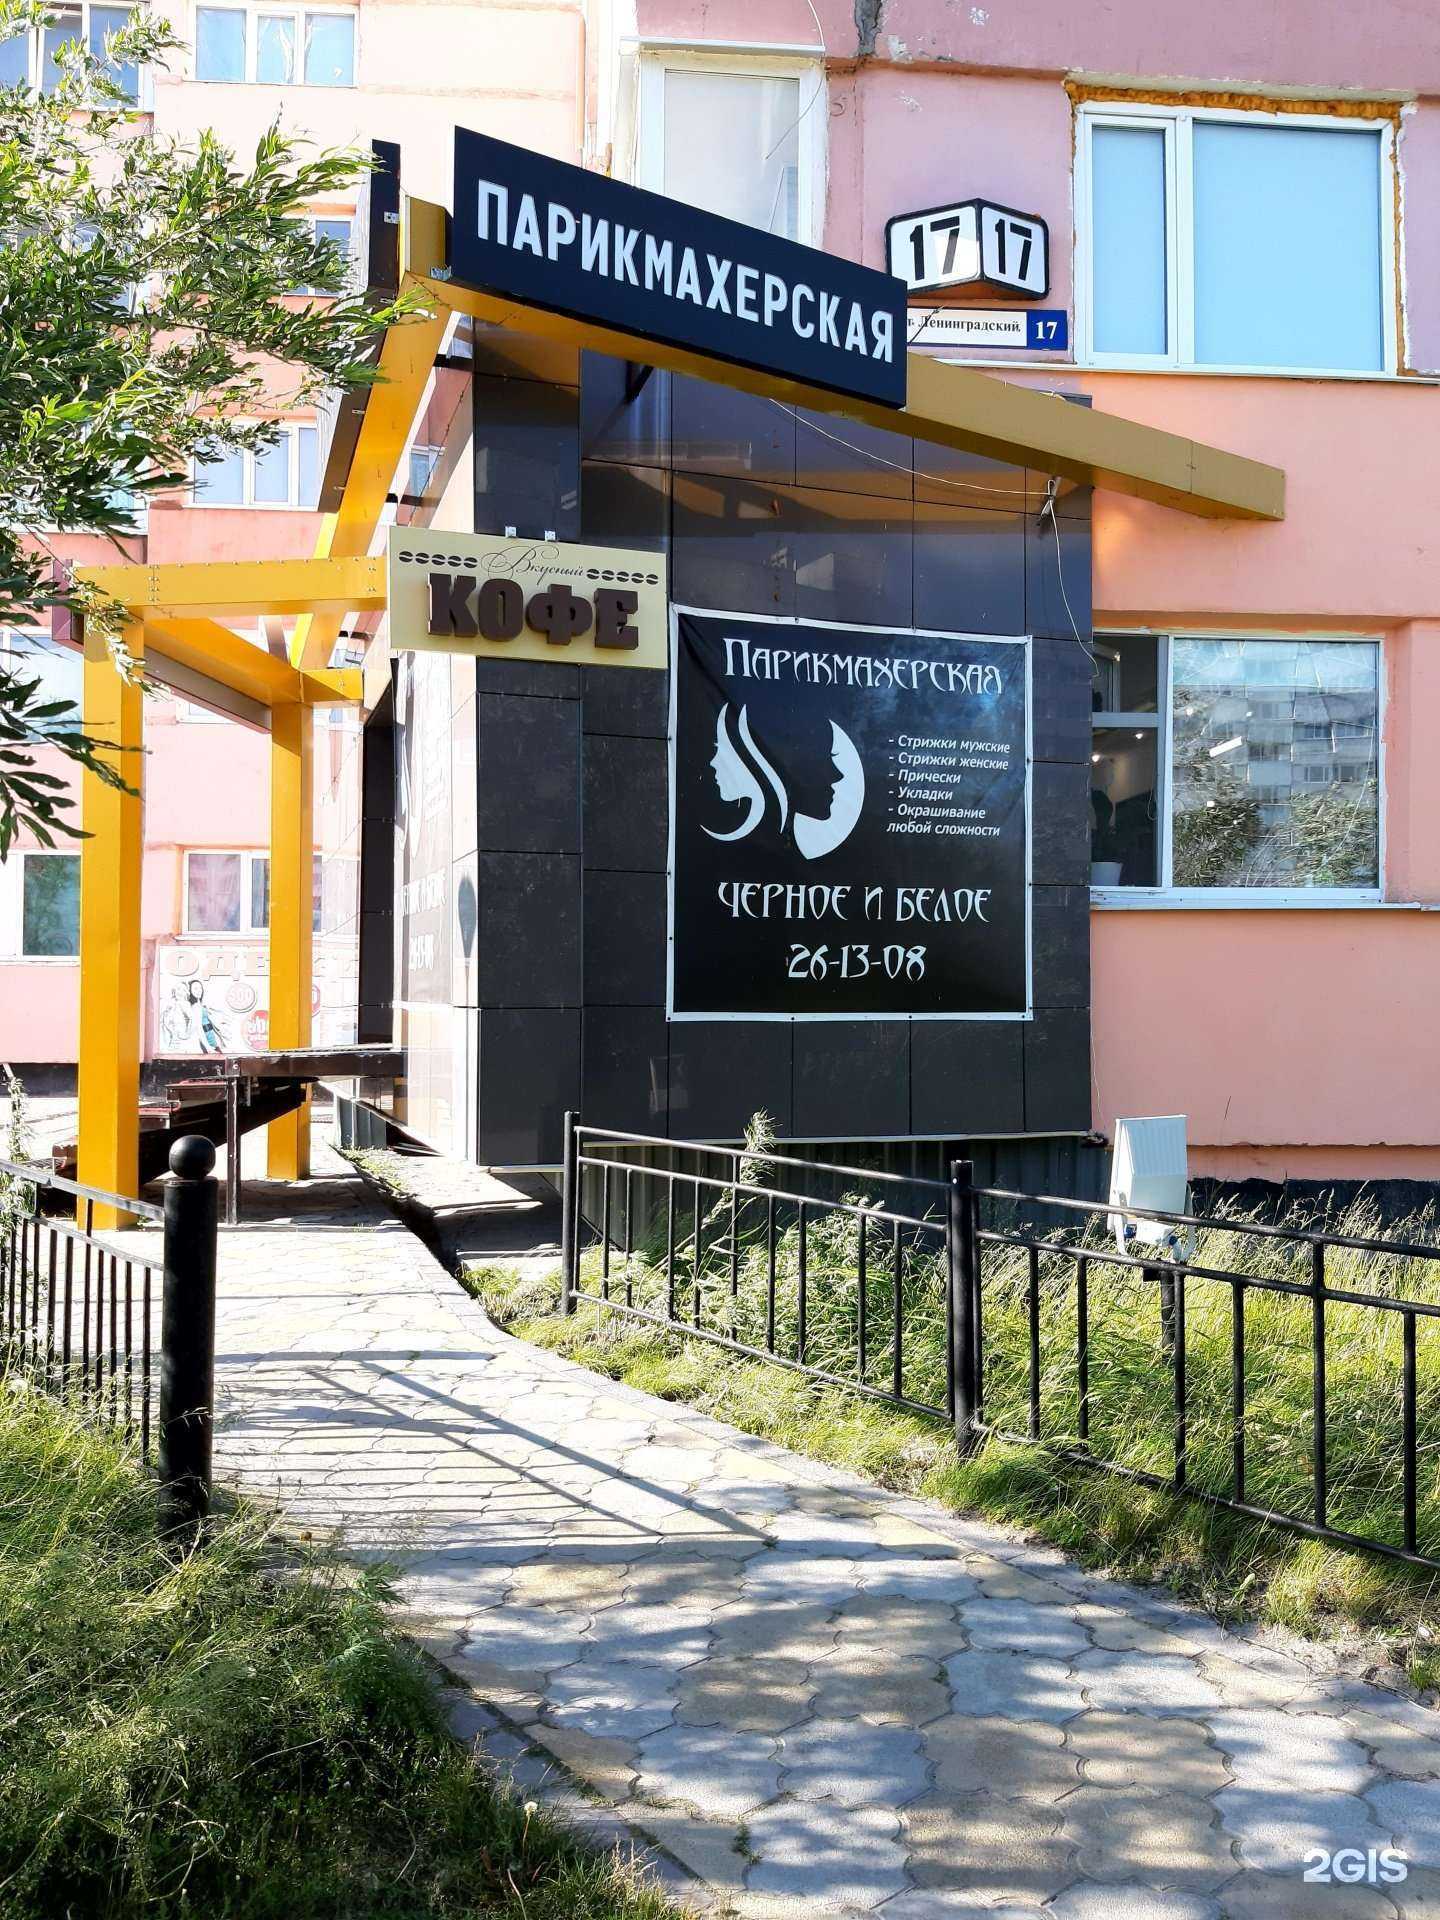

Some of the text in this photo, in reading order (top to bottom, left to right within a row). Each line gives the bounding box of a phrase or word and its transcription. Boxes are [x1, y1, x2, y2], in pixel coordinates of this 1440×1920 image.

[909, 215, 961, 281] 17
[994, 218, 1033, 281] 17
[476, 178, 895, 364] ПАРИКМАХЕРСКАЯ
[1035, 321, 1058, 340] 17
[481, 544, 583, 585] Вкусный
[427, 572, 639, 650] КОФЕ
[898, 734, 957, 751] Стрижки
[960, 739, 1010, 754] мужские
[898, 752, 957, 768] Стрижки
[959, 757, 1009, 771] женские
[898, 768, 962, 785] Прически
[897, 786, 953, 802] Укладки
[897, 803, 986, 820] Окрашивание
[886, 820, 1001, 838] любой сложности
[718, 882, 851, 921] ЧЕРНОЕ
[896, 887, 991, 923] БЕЛОЕ
[788, 943, 928, 982] 26-13-08
